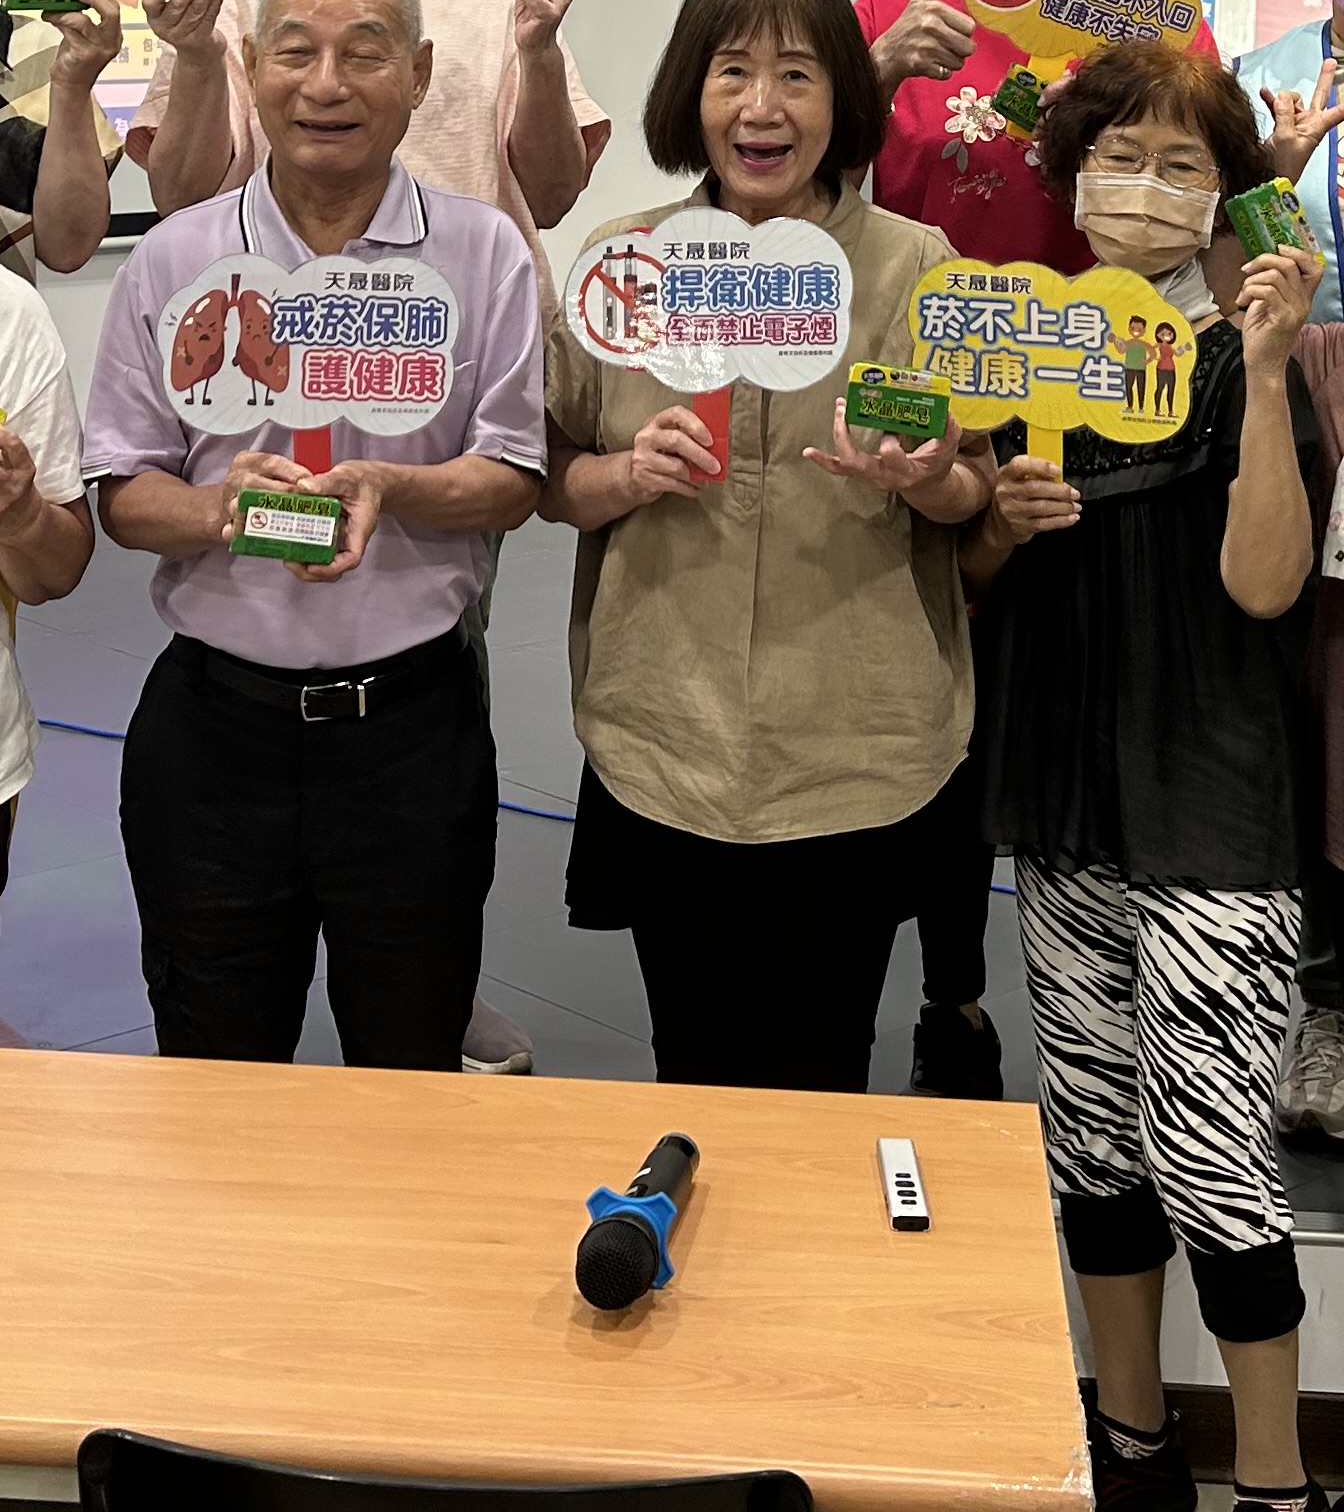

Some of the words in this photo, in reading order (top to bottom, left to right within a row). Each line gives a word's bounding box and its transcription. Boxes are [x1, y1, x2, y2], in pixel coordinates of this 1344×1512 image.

[662, 241, 751, 260] 天晟醫院
[324, 271, 415, 292] 天晟醫院
[661, 263, 841, 312] 捍衛健康
[945, 272, 1032, 295] 天晟醫院
[270, 292, 448, 347] 戒菸保肺
[666, 312, 839, 348] 全面禁止電子煙
[918, 293, 1110, 350] 菸不上身
[301, 349, 447, 404] 護健康
[928, 345, 1127, 400] 健康一生
[860, 397, 930, 425] 水晶肥皂
